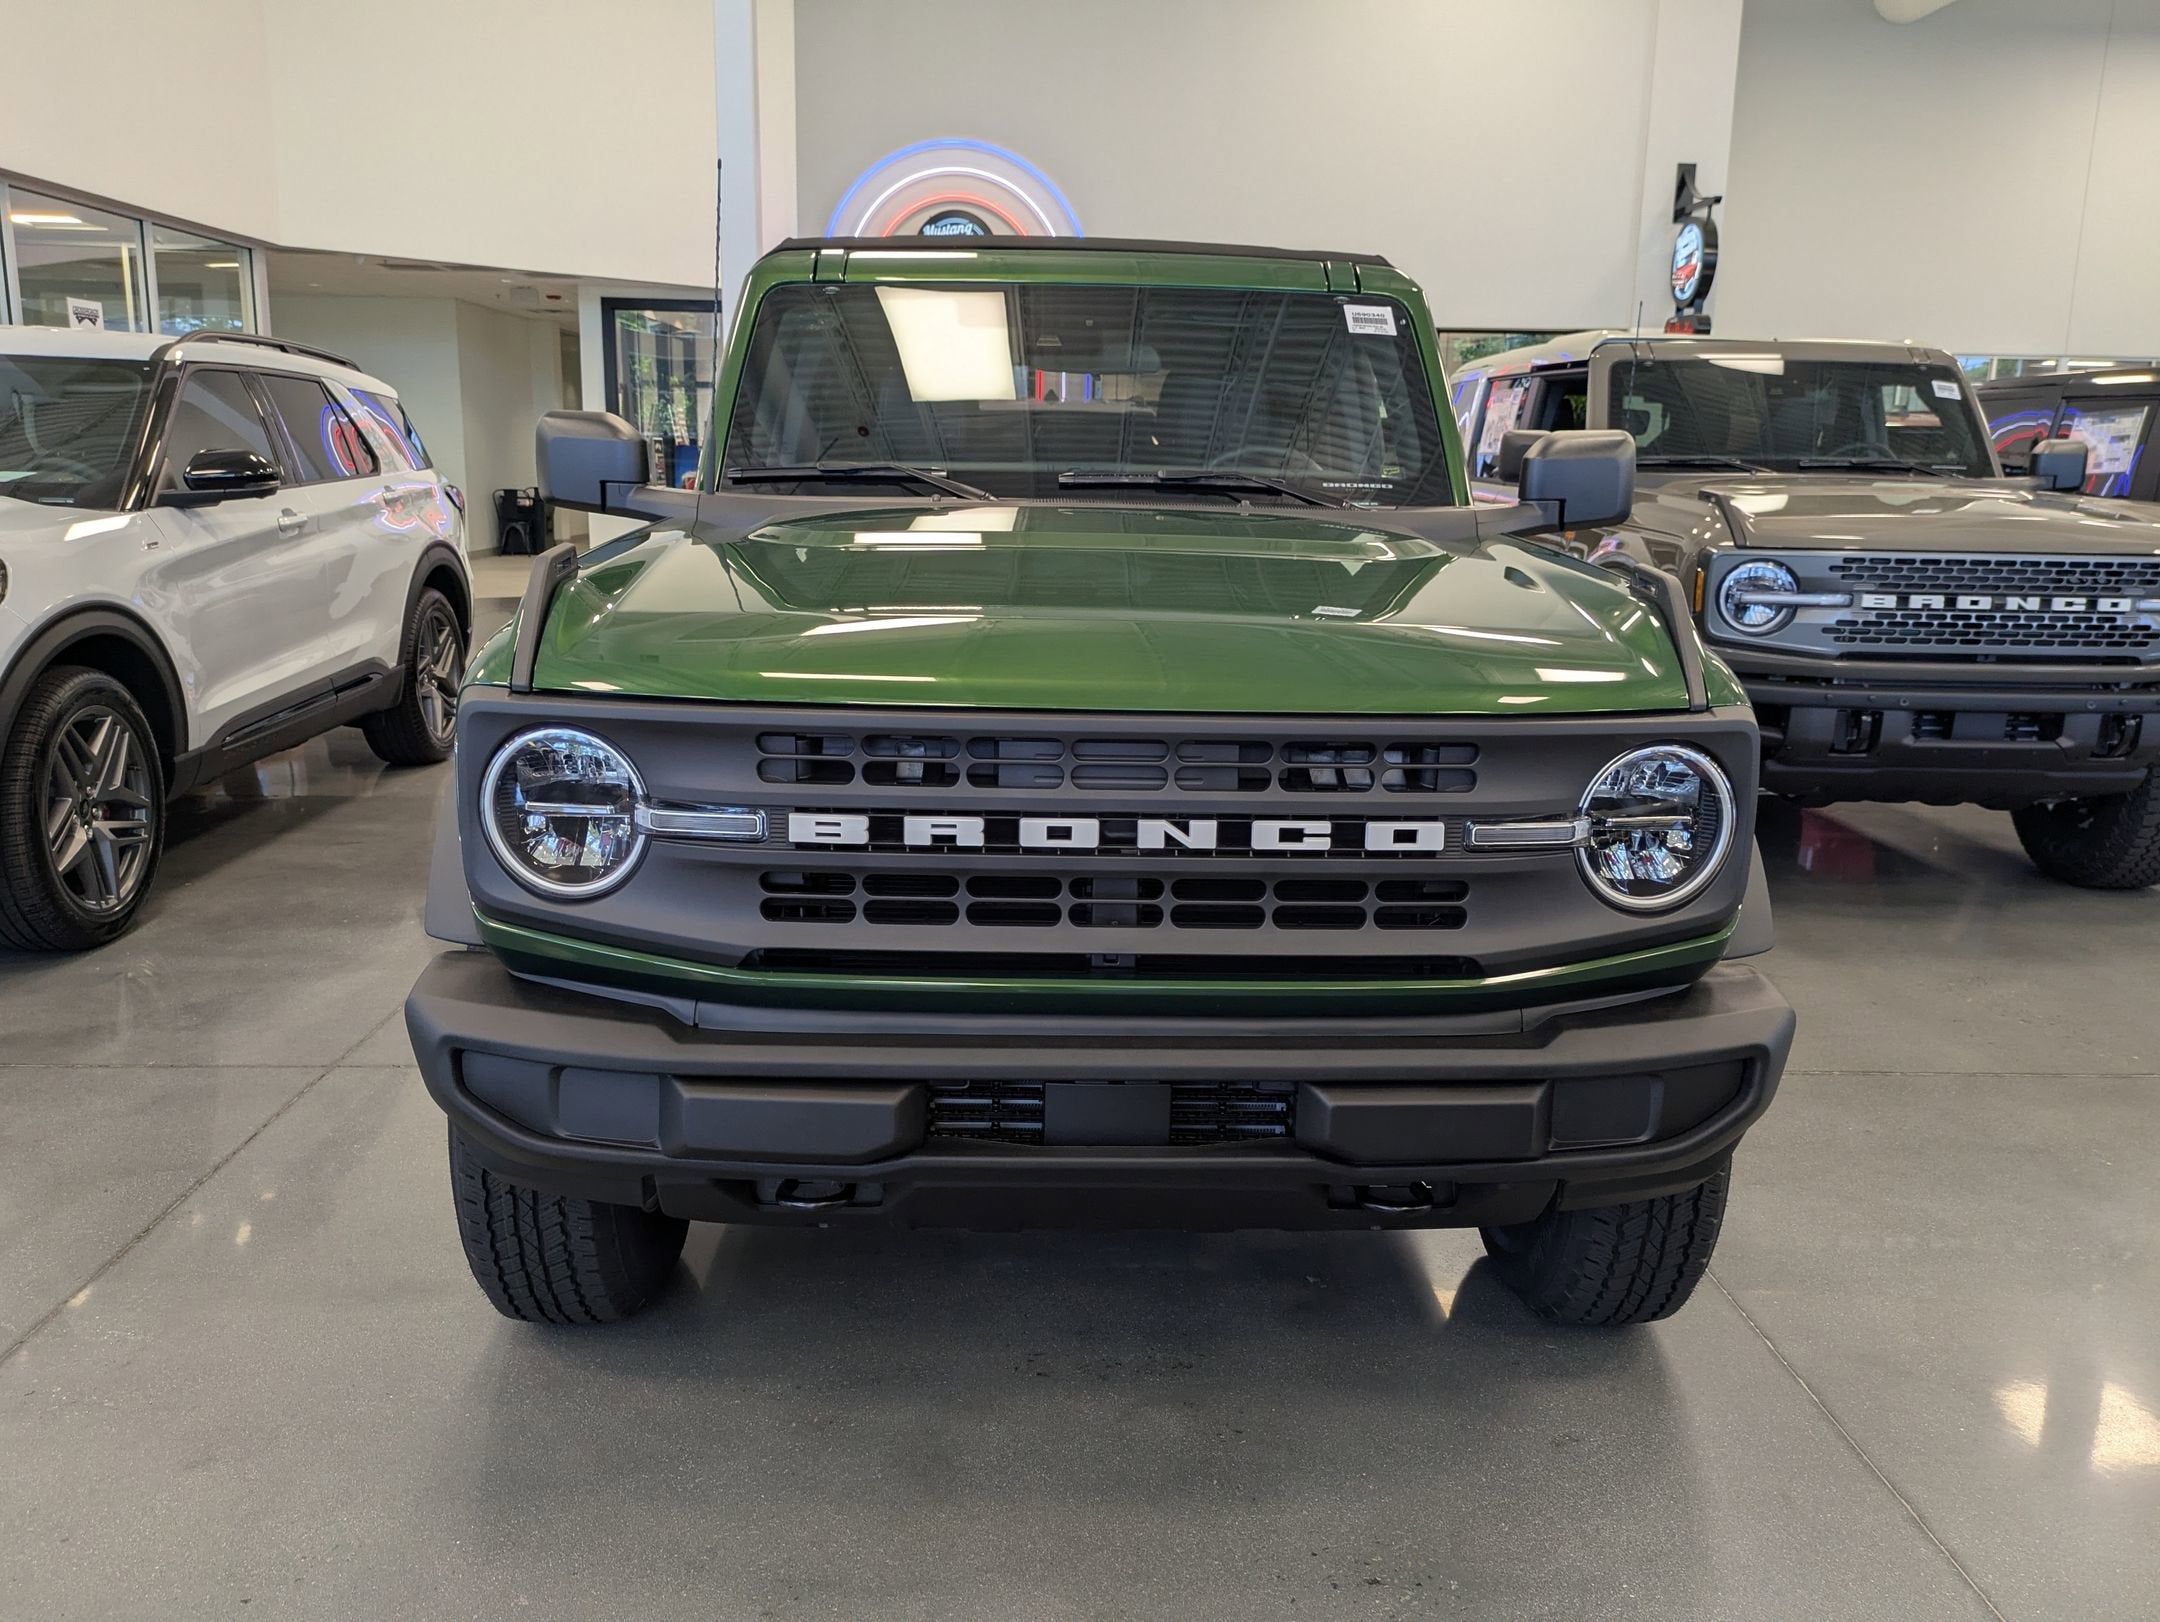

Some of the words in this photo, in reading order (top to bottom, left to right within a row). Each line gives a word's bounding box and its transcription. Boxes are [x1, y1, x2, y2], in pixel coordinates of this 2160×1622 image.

[922, 222, 975, 236] Mustang
[1860, 593, 2132, 612] BRONCO
[788, 813, 1446, 852] BRONCO
